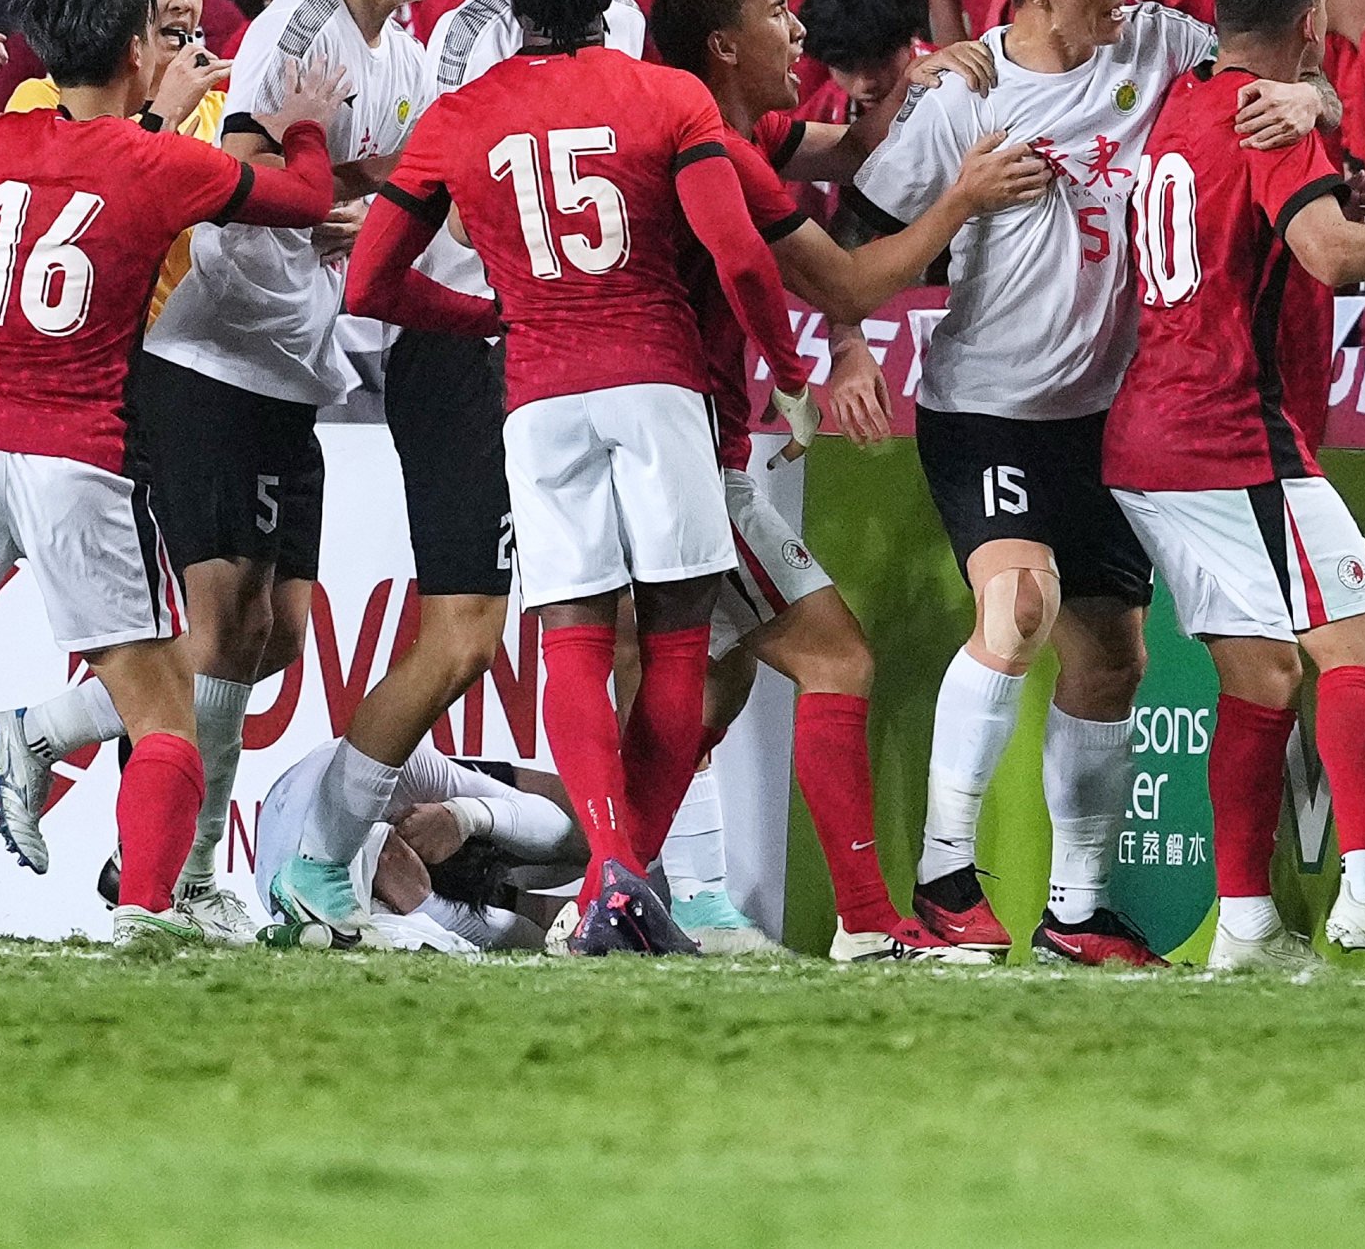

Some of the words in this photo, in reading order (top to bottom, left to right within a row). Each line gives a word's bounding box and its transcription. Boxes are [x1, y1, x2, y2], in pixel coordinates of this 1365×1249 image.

[488, 126, 631, 280] 15
[1132, 152, 1201, 308] 10
[256, 474, 280, 534] 5
[983, 465, 1029, 518] 15
[1132, 706, 1210, 755] sons
